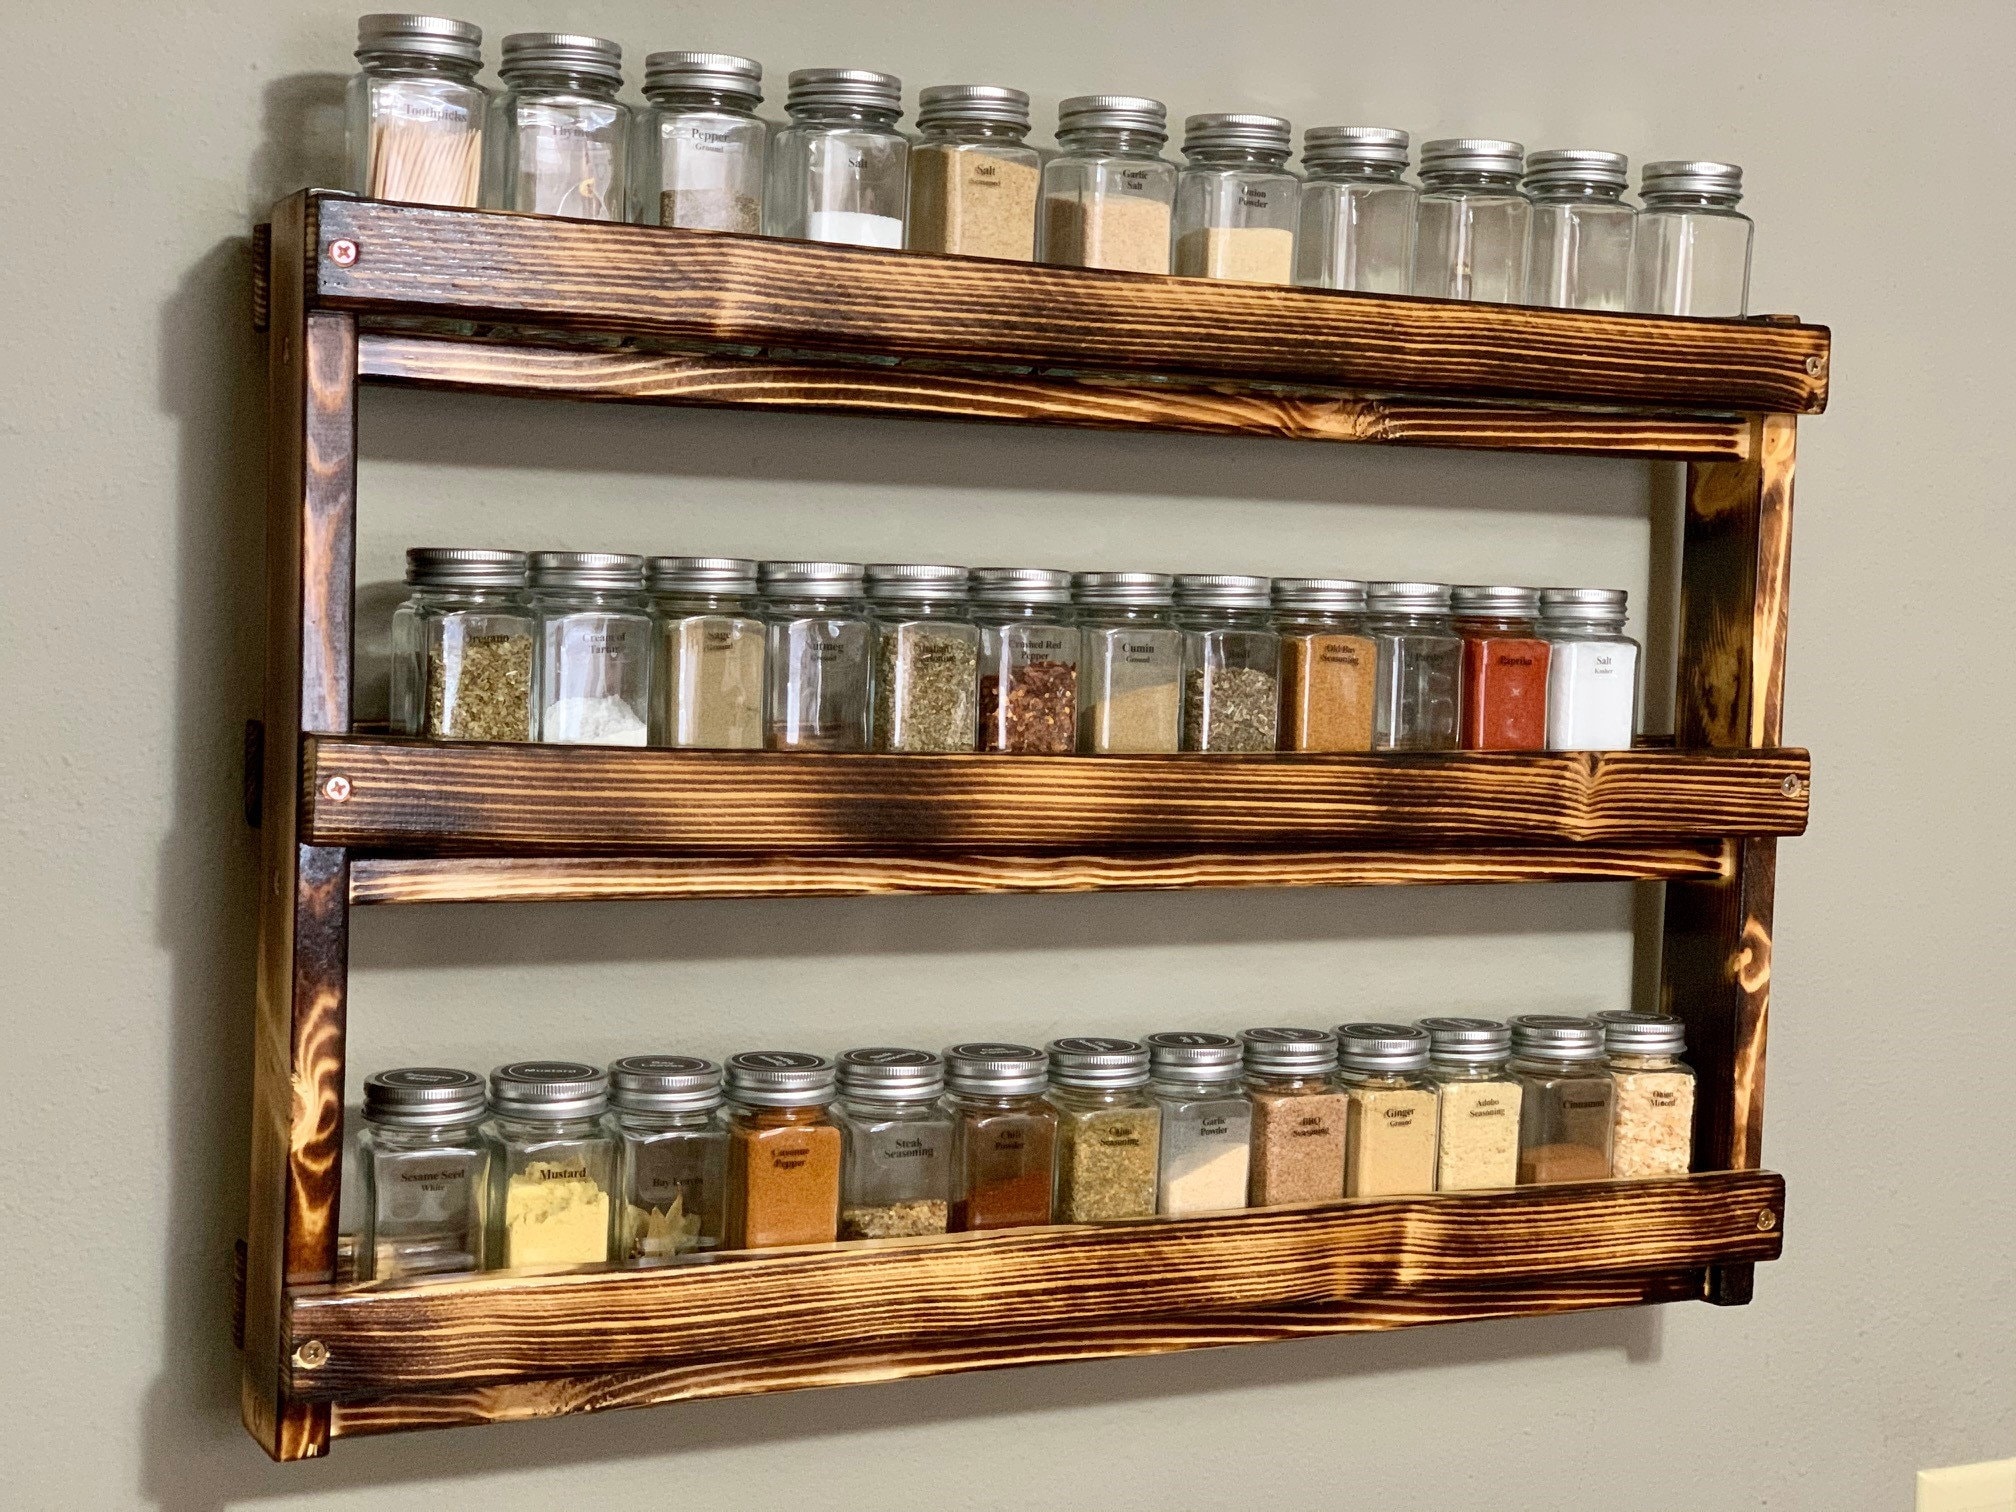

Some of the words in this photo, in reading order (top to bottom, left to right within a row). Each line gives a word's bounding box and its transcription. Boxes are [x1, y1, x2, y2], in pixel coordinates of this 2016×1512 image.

[405, 103, 468, 123] Toothpicks
[692, 128, 729, 143] Pepper
[848, 157, 868, 170] Salt
[976, 165, 996, 176] Salt
[1123, 169, 1147, 180] Garlic
[1128, 181, 1143, 191] Salt
[1242, 187, 1267, 199] Onion
[1239, 197, 1268, 209] Powder
[583, 634, 614, 643] Cream
[1046, 640, 1062, 650] Red
[1122, 643, 1155, 654] Cumin
[1022, 651, 1049, 662] Pepper
[1500, 655, 1533, 668] Paprika
[1597, 656, 1612, 666] Salt
[1476, 1098, 1500, 1107] Adobo
[1562, 1099, 1605, 1111] Cinnamon
[1385, 1107, 1416, 1120] Ginger
[1469, 1107, 1506, 1118] Seasoning
[1202, 1117, 1226, 1127] Garlic
[1302, 1116, 1321, 1127] BBQ
[1200, 1126, 1228, 1137] Powder
[896, 1138, 923, 1149] Steak
[995, 1141, 1024, 1152] Powder
[1100, 1137, 1140, 1148] Seasoning
[884, 1147, 934, 1160] Seasoning
[773, 1158, 805, 1170] Pepper
[401, 1173, 439, 1183] Sesame
[441, 1169, 465, 1181] Seed
[540, 1167, 587, 1181] Mustard
[653, 1178, 669, 1189] Bay
